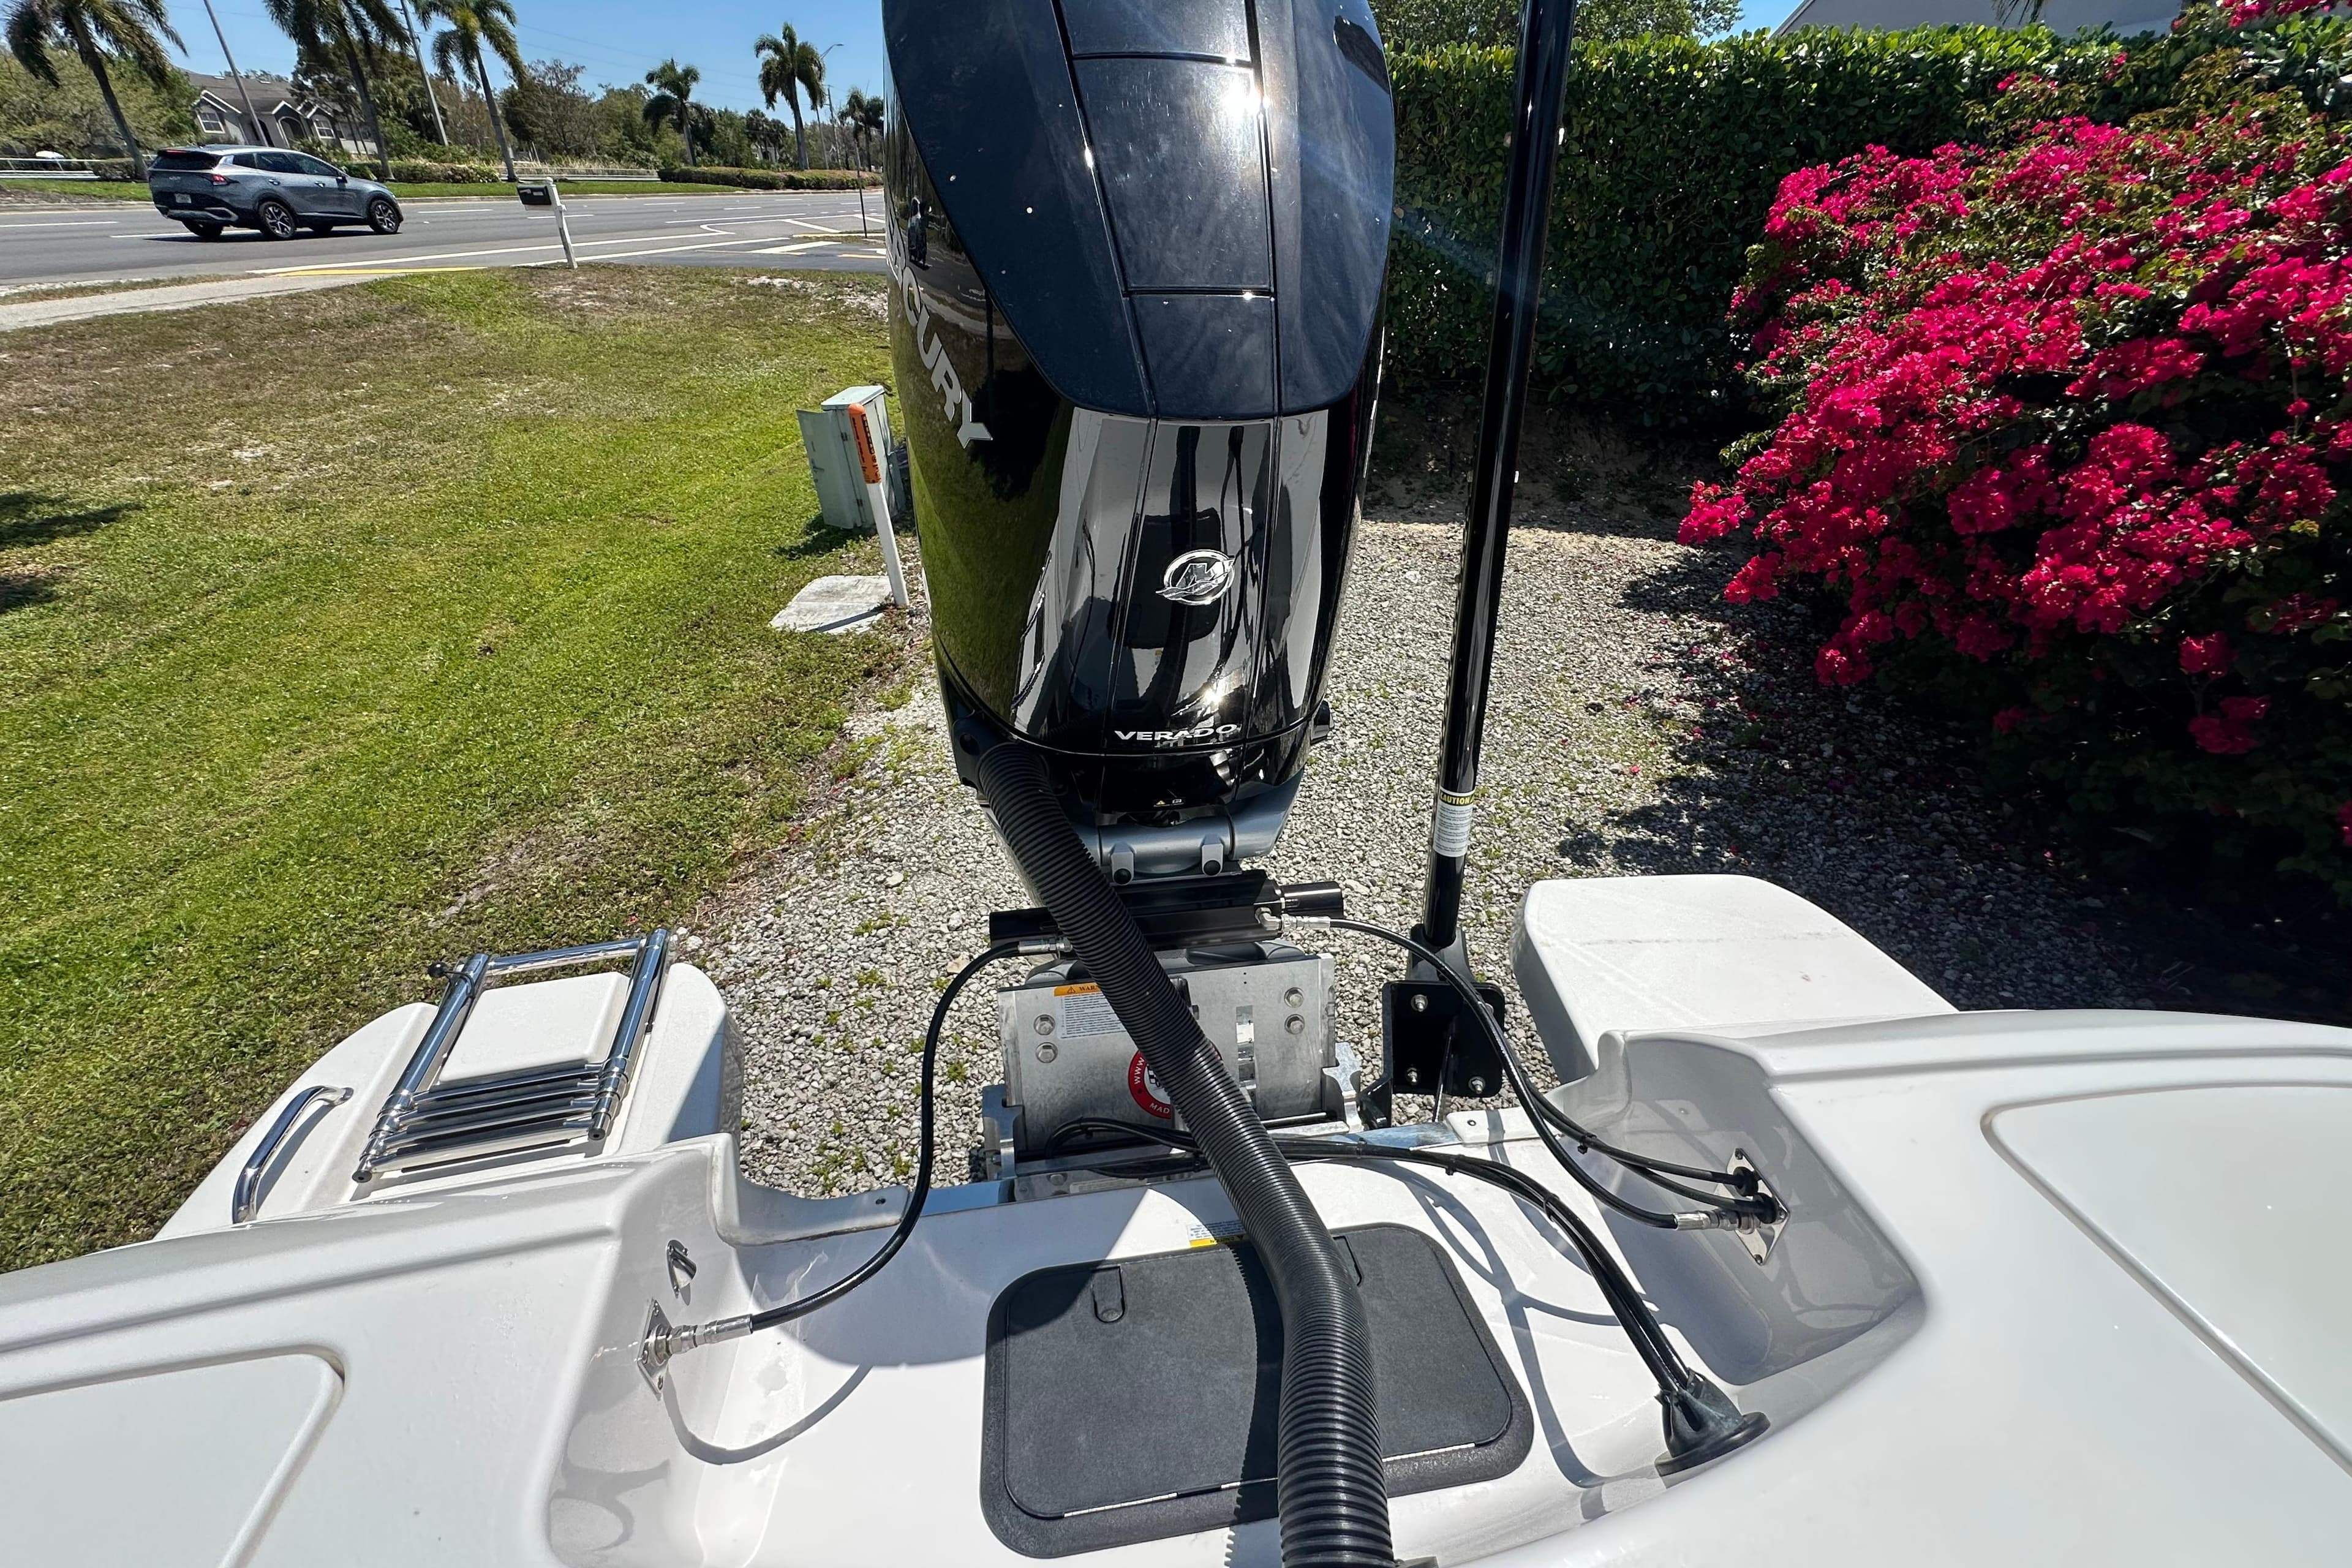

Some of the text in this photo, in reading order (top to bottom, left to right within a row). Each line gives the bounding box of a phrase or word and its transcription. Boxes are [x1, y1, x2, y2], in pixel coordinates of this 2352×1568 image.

[886, 179, 992, 449] ERCURY
[1115, 724, 1237, 741] VERADO
[1441, 791, 1469, 805] CAUTION
[1134, 1057, 1145, 1085] WWW
[1150, 1102, 1170, 1114] MAD
